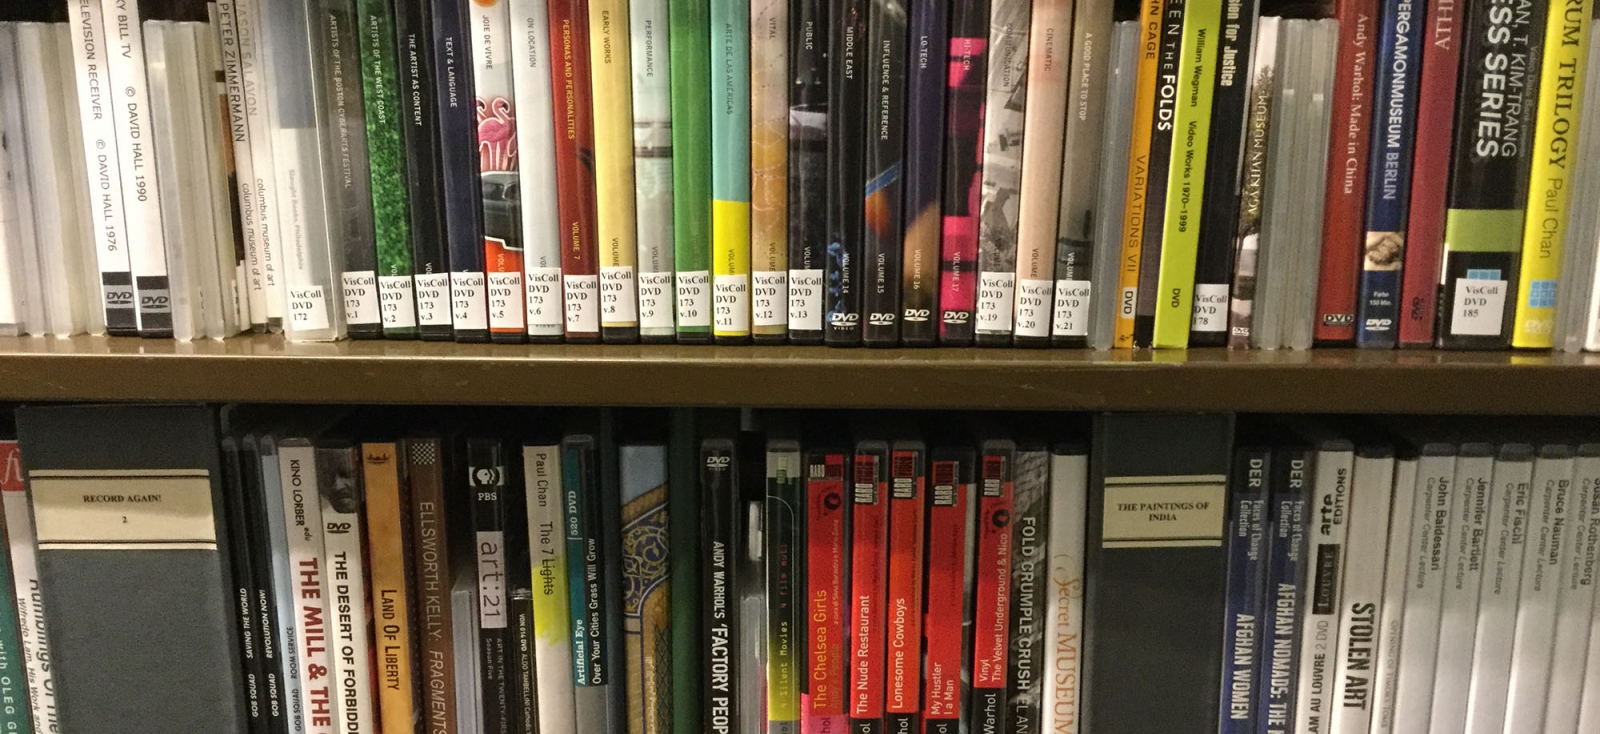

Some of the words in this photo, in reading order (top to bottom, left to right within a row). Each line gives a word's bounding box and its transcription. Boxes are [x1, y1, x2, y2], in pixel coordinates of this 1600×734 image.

[118, 15, 129, 40] BILL
[220, 3, 234, 46] PETER
[563, 19, 572, 61] PERSONAS
[1145, 23, 1158, 59] CAGE
[1226, 25, 1240, 41] for
[1353, 14, 1369, 48] Andy
[121, 44, 131, 58] TV
[485, 47, 493, 70] VIVRE
[645, 20, 654, 78] PERFORMANCE
[920, 36, 928, 69] LO-TECH
[1045, 28, 1054, 71] CINEMATIC
[1164, 42, 1175, 69] THE
[1195, 29, 1206, 63] William
[410, 50, 418, 78] ARTIST
[845, 58, 853, 80] EAST
[1221, 46, 1238, 86] Justice
[1352, 51, 1366, 101] Warhol:
[88, 64, 102, 120] RECEIVER
[225, 51, 245, 142] ZIMMERMANN
[448, 66, 458, 108] LANGUAGE
[1158, 75, 1176, 131] FOLDS
[1191, 66, 1202, 107] Wegman
[128, 103, 140, 140] DAVID
[413, 91, 422, 126] CONTENT
[565, 79, 576, 140] PERSONALITIES
[1349, 104, 1362, 139] Made
[1477, 52, 1508, 157] SERIES
[1501, 53, 1526, 157] KIM-TRANG
[1549, 58, 1577, 170] TRILOGY
[1187, 121, 1197, 147] Video
[1347, 141, 1357, 156] in
[132, 142, 144, 172] HALL
[1184, 150, 1194, 178] Works
[1247, 190, 1260, 215] AGA
[1254, 95, 1269, 148] MUSEUM
[98, 154, 110, 191] DAVID
[134, 175, 148, 202] 1990
[1344, 158, 1358, 194] China
[1383, 152, 1400, 200] BERLIN
[103, 192, 114, 221] HALL
[1128, 155, 1146, 249] VARIATIONS
[1544, 178, 1564, 212] Paul
[105, 225, 118, 252] 1976
[242, 182, 253, 225] columbus
[248, 229, 258, 266] museum
[1539, 218, 1559, 259] Chan
[1127, 255, 1137, 272] VII
[290, 290, 322, 299] VisColl
[344, 277, 374, 285] VisColl
[566, 281, 597, 289] VisColl
[791, 277, 822, 285] VisColl
[1171, 288, 1181, 308] DVD
[1466, 286, 1498, 295] VisColl
[292, 302, 313, 310] DVD
[347, 311, 358, 319] v.1
[1124, 291, 1133, 314] DVD
[1463, 309, 1479, 317] 185
[1464, 298, 1487, 306] DVD
[291, 459, 302, 486] KINO
[536, 454, 548, 477] Paul
[1249, 459, 1263, 488] DER
[83, 494, 124, 503] RECORD
[127, 494, 161, 503] AGAIN!
[293, 490, 305, 526] LORBER
[537, 480, 549, 507] Chan
[568, 491, 577, 513] DVD
[1117, 503, 1137, 511] THE
[1140, 502, 1194, 510] PAINTINGS
[1333, 468, 1347, 525] EDITIONS
[1437, 477, 1450, 508] John
[1474, 477, 1488, 531] Jennifer
[1516, 483, 1529, 506] Eric
[1556, 479, 1569, 514] Bruce
[1320, 494, 1333, 536] arte
[1512, 509, 1526, 545] Fischl
[420, 502, 439, 591] ELLSWORTH
[540, 521, 553, 544] The
[587, 538, 596, 561] Grow
[998, 534, 1008, 555] Nico
[1022, 517, 1036, 556] FOLD
[1431, 510, 1447, 571] Baldessari
[1550, 518, 1565, 565] Nauman
[335, 552, 348, 580] THE
[713, 541, 725, 568] ANDY
[1469, 529, 1484, 571] Bartlett
[299, 557, 321, 599] THE
[481, 542, 503, 617] art:21
[540, 558, 553, 595] Lights
[588, 564, 596, 581] Will
[240, 588, 248, 615] WORLD
[589, 583, 598, 609] Grass
[814, 590, 827, 622] Girls
[995, 568, 1007, 631] Underground
[1020, 563, 1034, 634] CRUMPLE
[1275, 583, 1296, 634] AFGHAN
[18, 598, 29, 637] Wifredo
[337, 585, 353, 642] DESERT
[576, 619, 585, 638] Eye
[590, 612, 600, 638] Cities
[858, 595, 870, 657] Restaurant
[893, 598, 907, 648] Cowboys
[1316, 620, 1329, 641] DVD
[261, 613, 273, 658] REVOLUTION
[303, 606, 325, 657] MILL
[993, 632, 1003, 662] Velvet
[1234, 614, 1255, 665] AFGHAN
[1347, 602, 1376, 670] STOLEN
[342, 645, 354, 665] OF
[575, 640, 585, 685] Artificial
[592, 640, 601, 661] Your
[814, 627, 827, 681] Chelsea
[1018, 639, 1032, 689] CRUSH
[28, 668, 36, 683] His
[308, 664, 327, 681] &
[593, 664, 602, 684] Over
[857, 661, 868, 690] Nude
[892, 654, 904, 709] Lonesome
[931, 662, 942, 698] Hustler
[979, 659, 991, 682] Vinyl
[992, 664, 1001, 681] The
[1270, 639, 1292, 699] NOMADS:
[1312, 653, 1325, 694] LOUVRE
[1, 677, 15, 714] OLEG
[30, 687, 40, 711] Work
[248, 674, 257, 699] SQUAD
[814, 685, 826, 709] The
[1231, 669, 1251, 720] WOMEN
[1343, 675, 1368, 710] ART
[310, 686, 331, 726] THE
[857, 695, 867, 714] The
[931, 701, 943, 715] My
[1268, 703, 1287, 726] THE
[1310, 698, 1321, 712] AU
